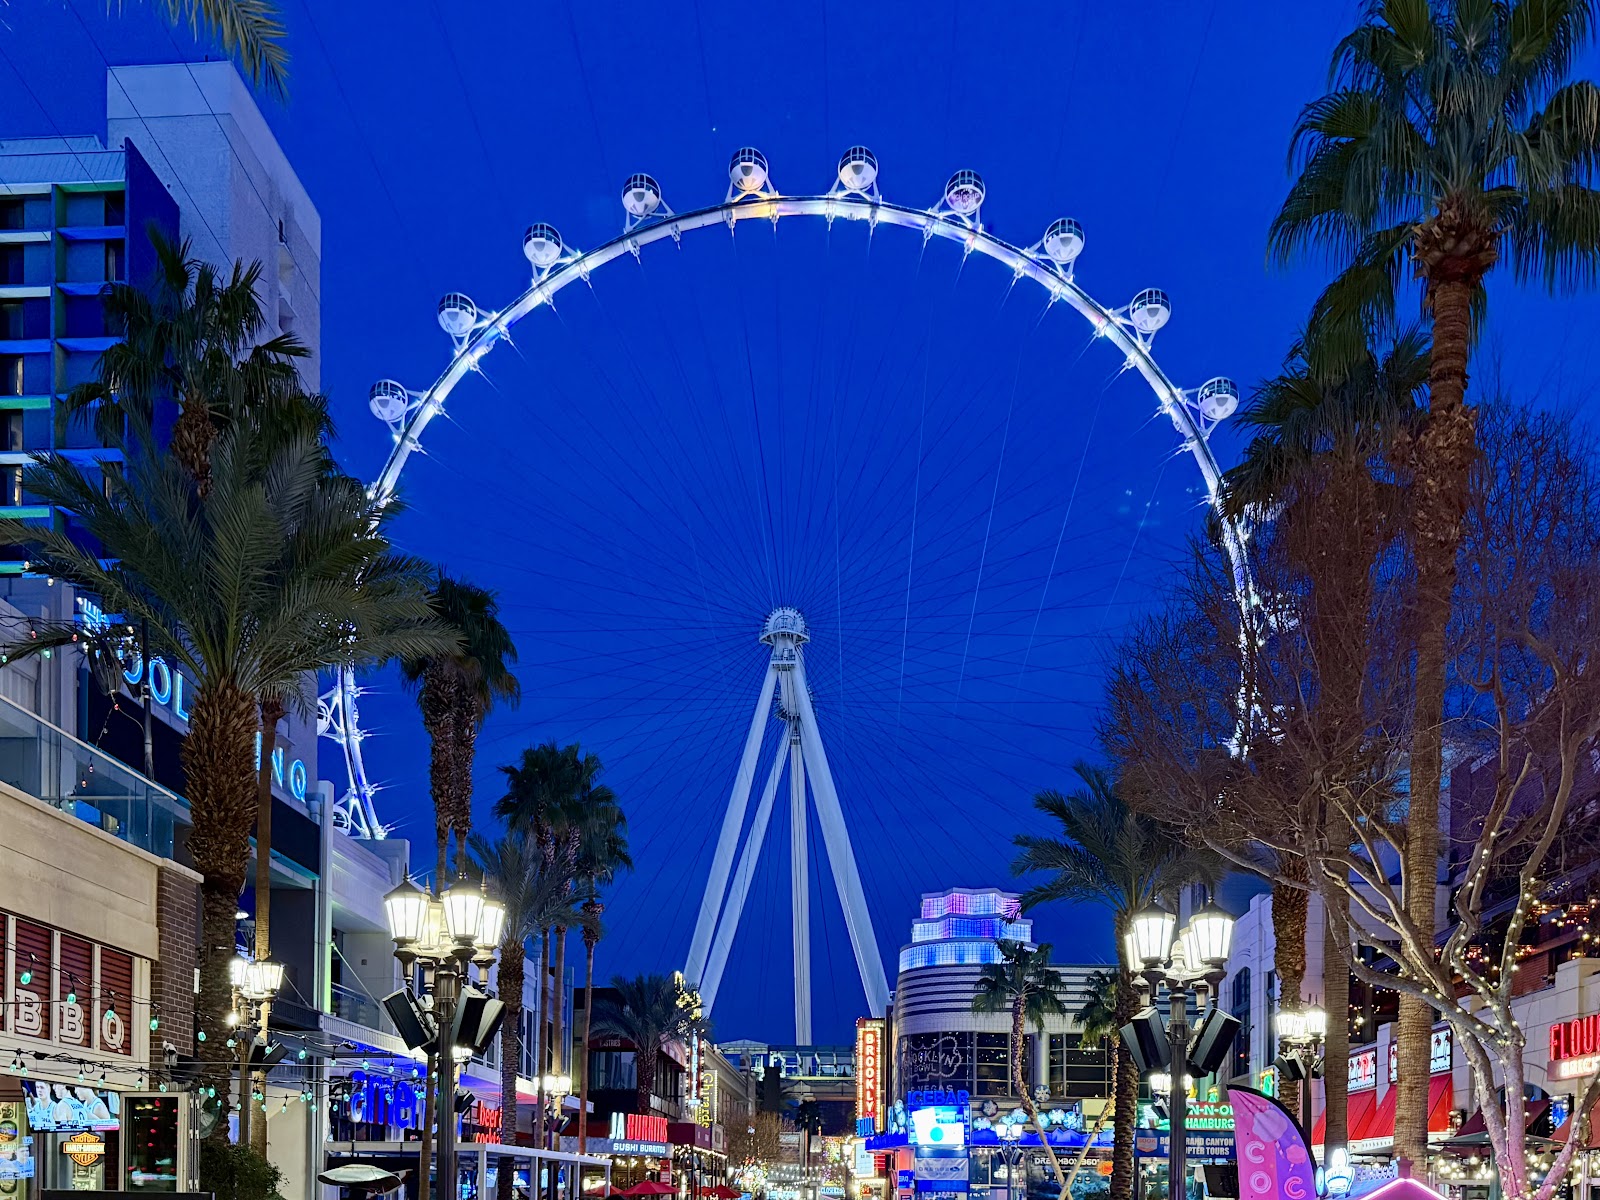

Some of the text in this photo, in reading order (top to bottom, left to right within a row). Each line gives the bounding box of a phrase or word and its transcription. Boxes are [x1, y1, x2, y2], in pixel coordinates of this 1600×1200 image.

[96, 636, 189, 722] OOL
[255, 731, 307, 804] INQ
[15, 987, 124, 1054] BBQ
[1549, 1013, 1600, 1061] FLOU
[865, 1033, 875, 1119] BROOKLYN
[701, 1072, 714, 1129] Ghirarde
[908, 1089, 969, 1106] ICEBAR
[479, 1100, 498, 1128] beer
[1187, 1104, 1234, 1116] N-N-O
[1185, 1117, 1235, 1129] HAMBURG
[74, 1135, 96, 1143] MOTOR
[475, 1127, 502, 1145] cockta
[1185, 1137, 1205, 1147] RAND
[1205, 1137, 1234, 1147] CANYON
[613, 1142, 666, 1154] SUSHI BURRITOS
[1205, 1146, 1230, 1156] TOURS
[74, 1153, 96, 1164] CYCLES
[1034, 1157, 1078, 1166] DREMBOX
